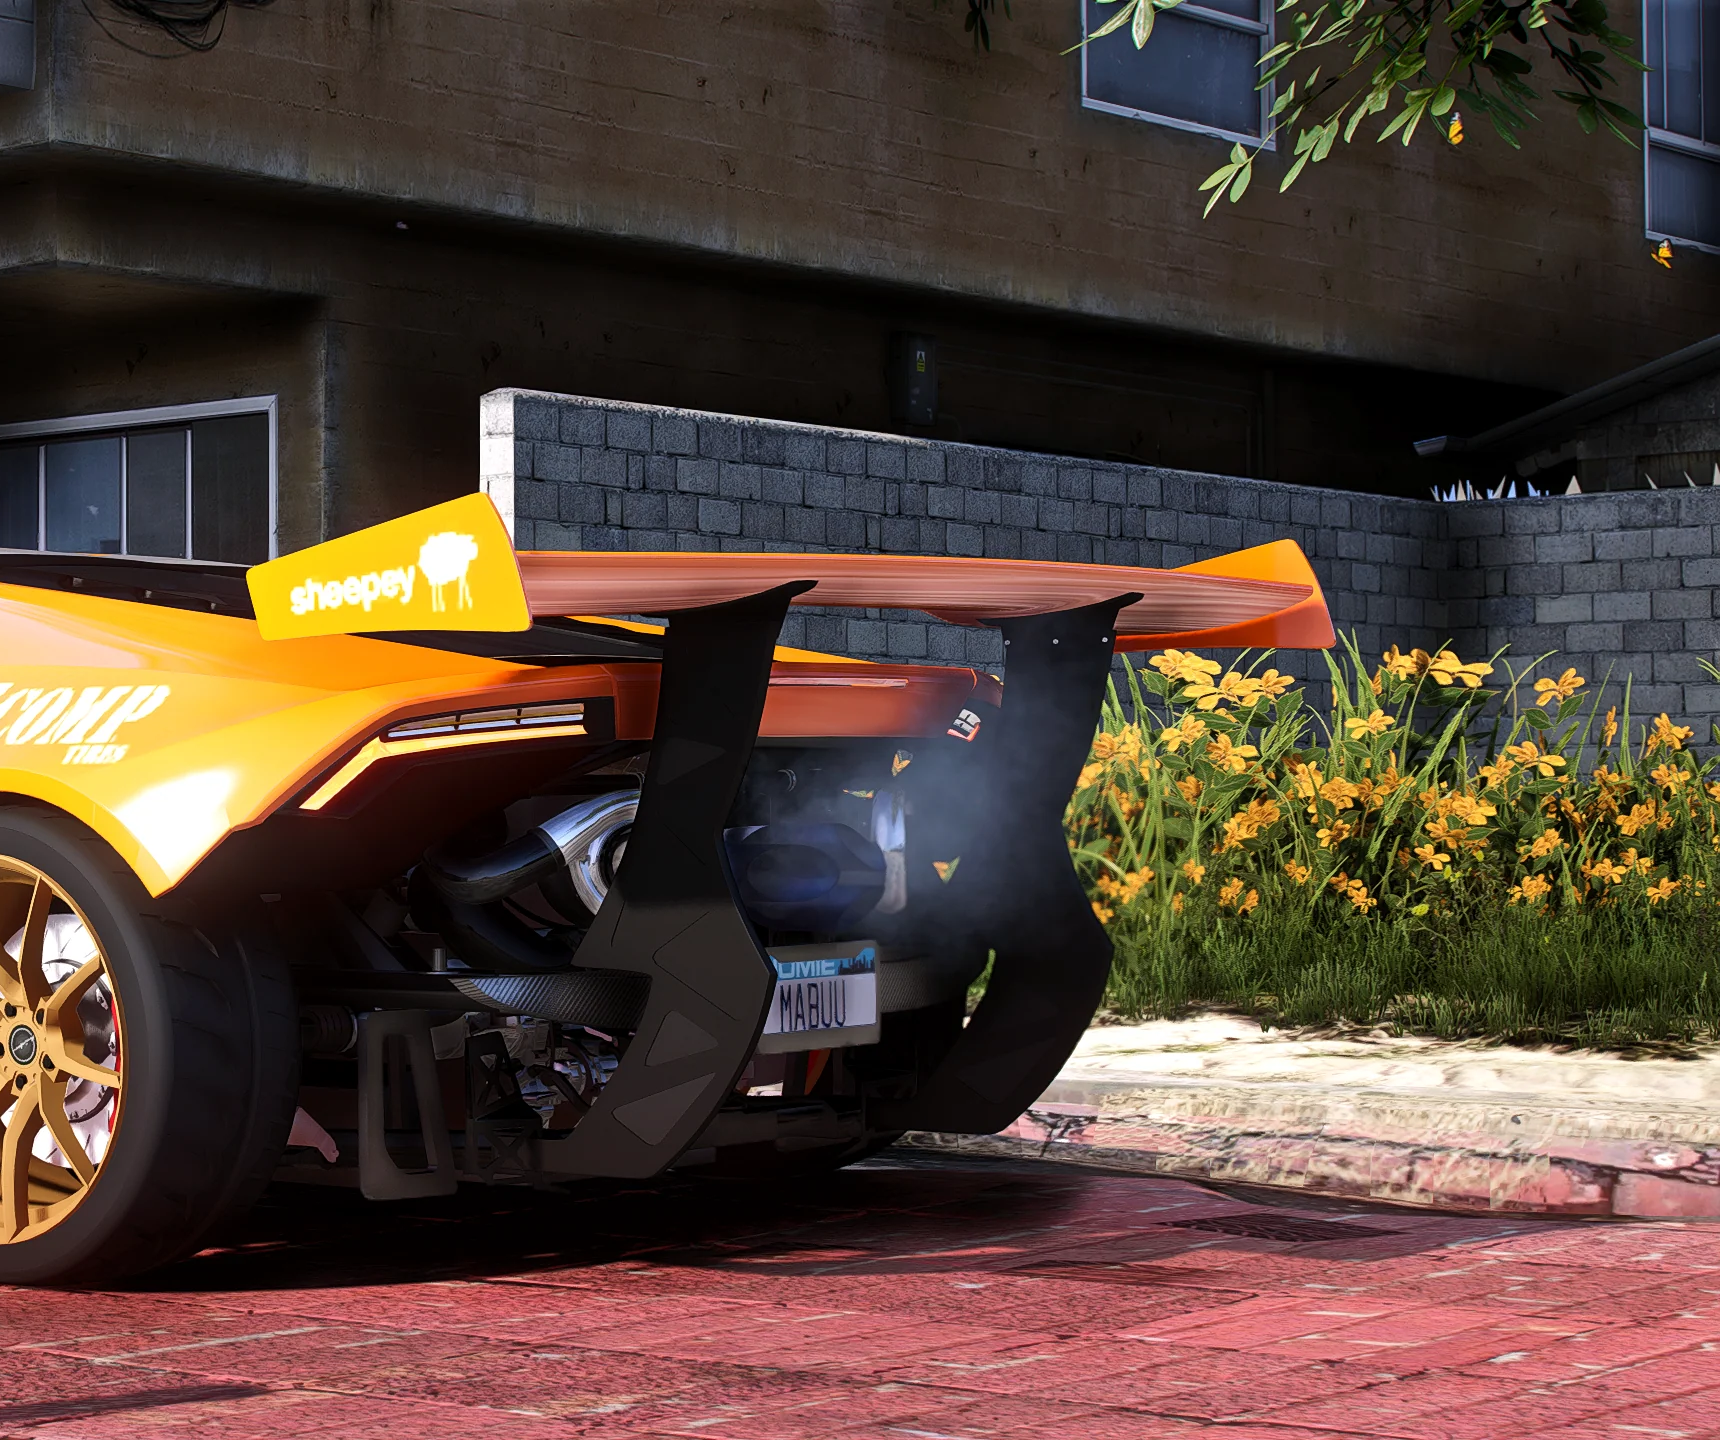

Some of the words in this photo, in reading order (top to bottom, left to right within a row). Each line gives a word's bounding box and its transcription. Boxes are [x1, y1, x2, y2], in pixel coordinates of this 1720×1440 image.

[290, 565, 416, 615] sheepey
[61, 744, 130, 766] TIRES
[770, 959, 836, 979] OMIE
[780, 979, 846, 1033] MABUU
